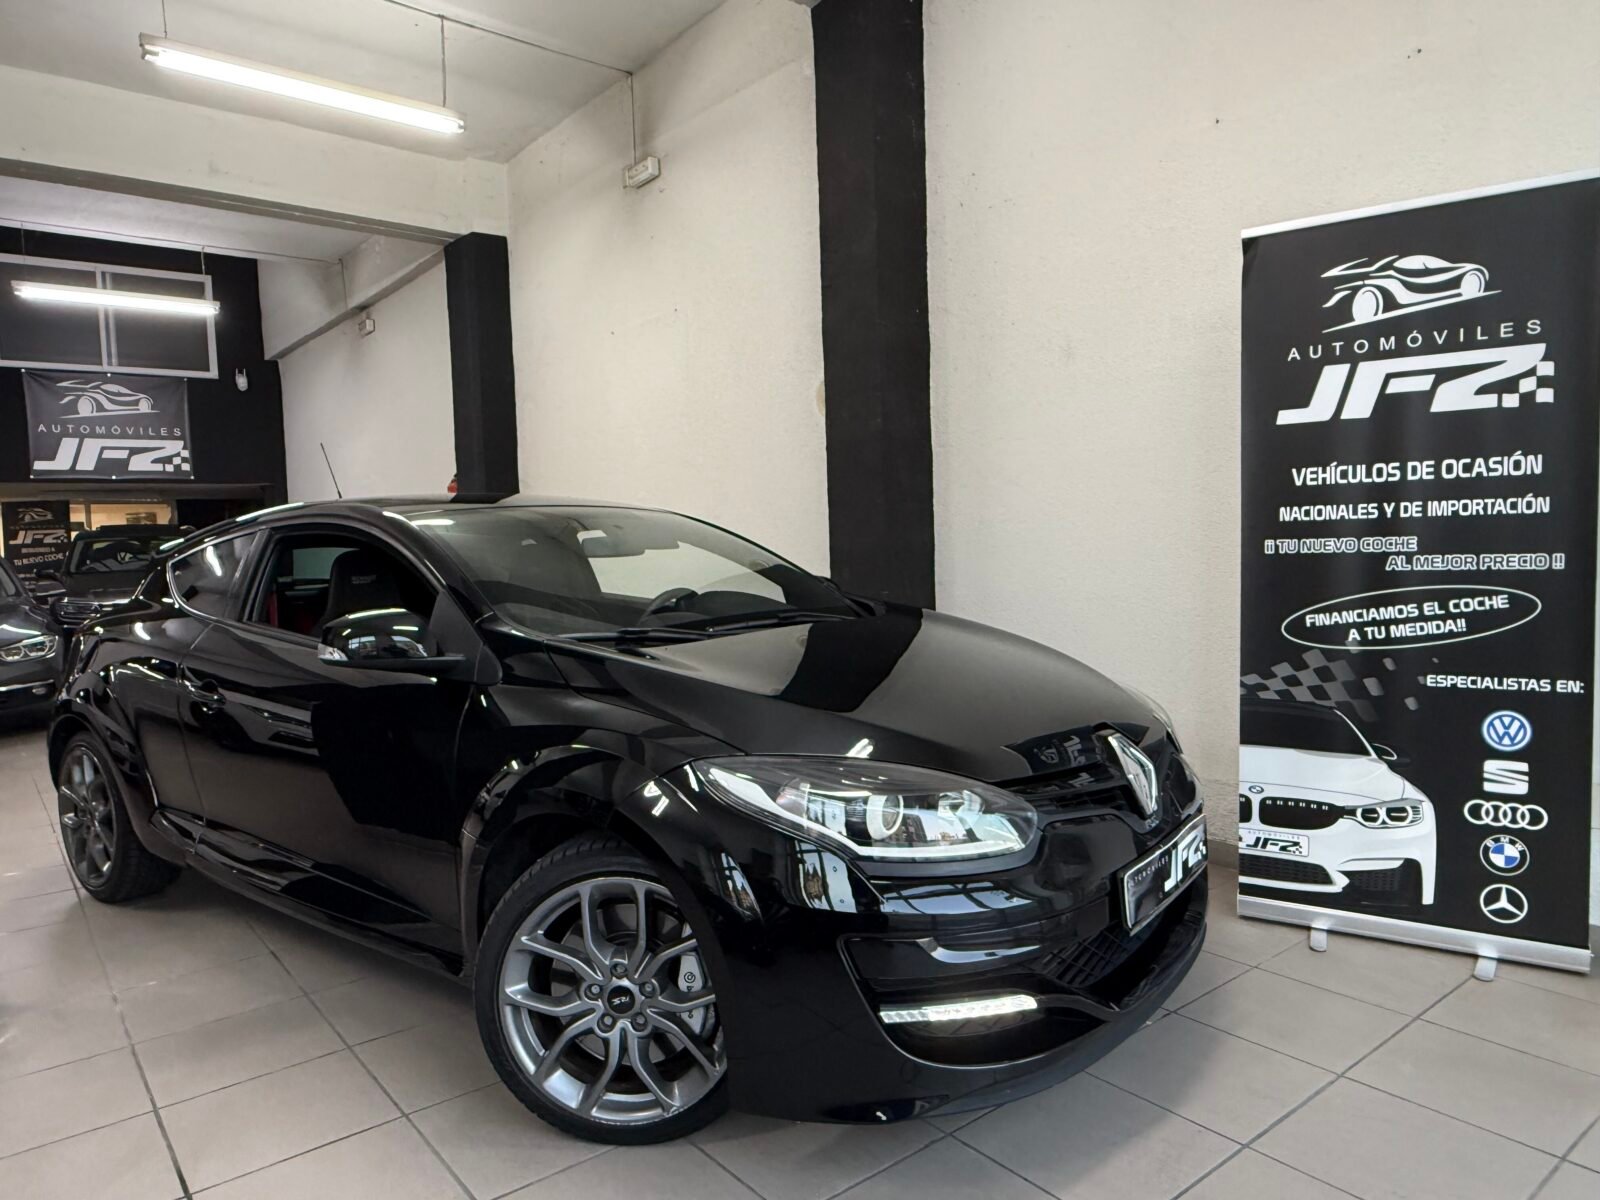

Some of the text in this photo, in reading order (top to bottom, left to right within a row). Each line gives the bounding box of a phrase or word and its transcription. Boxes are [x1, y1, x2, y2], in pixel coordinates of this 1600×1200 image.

[1288, 319, 1542, 361] AUTOMÓVILES
[1276, 343, 1548, 425] JFZ
[33, 437, 186, 471] JFZ
[1292, 450, 1543, 486] VEHÍCULOS DE OCASIÓN
[1279, 493, 1550, 522] NACIONALES Y DE IMPORTACIÓN
[9, 529, 67, 545] JFZ
[1300, 537, 1358, 554] NUEVO
[1360, 536, 1418, 552] COCHE
[1385, 555, 1411, 571] AL
[1413, 554, 1477, 570] MEJOR
[1305, 594, 1510, 627] FINANCIAMOS EL COCHE
[1348, 618, 1467, 641] A TU MEDIDA!!
[1426, 674, 1585, 693] ESPECIALISTAS EN:
[1245, 836, 1301, 854] JFZ
